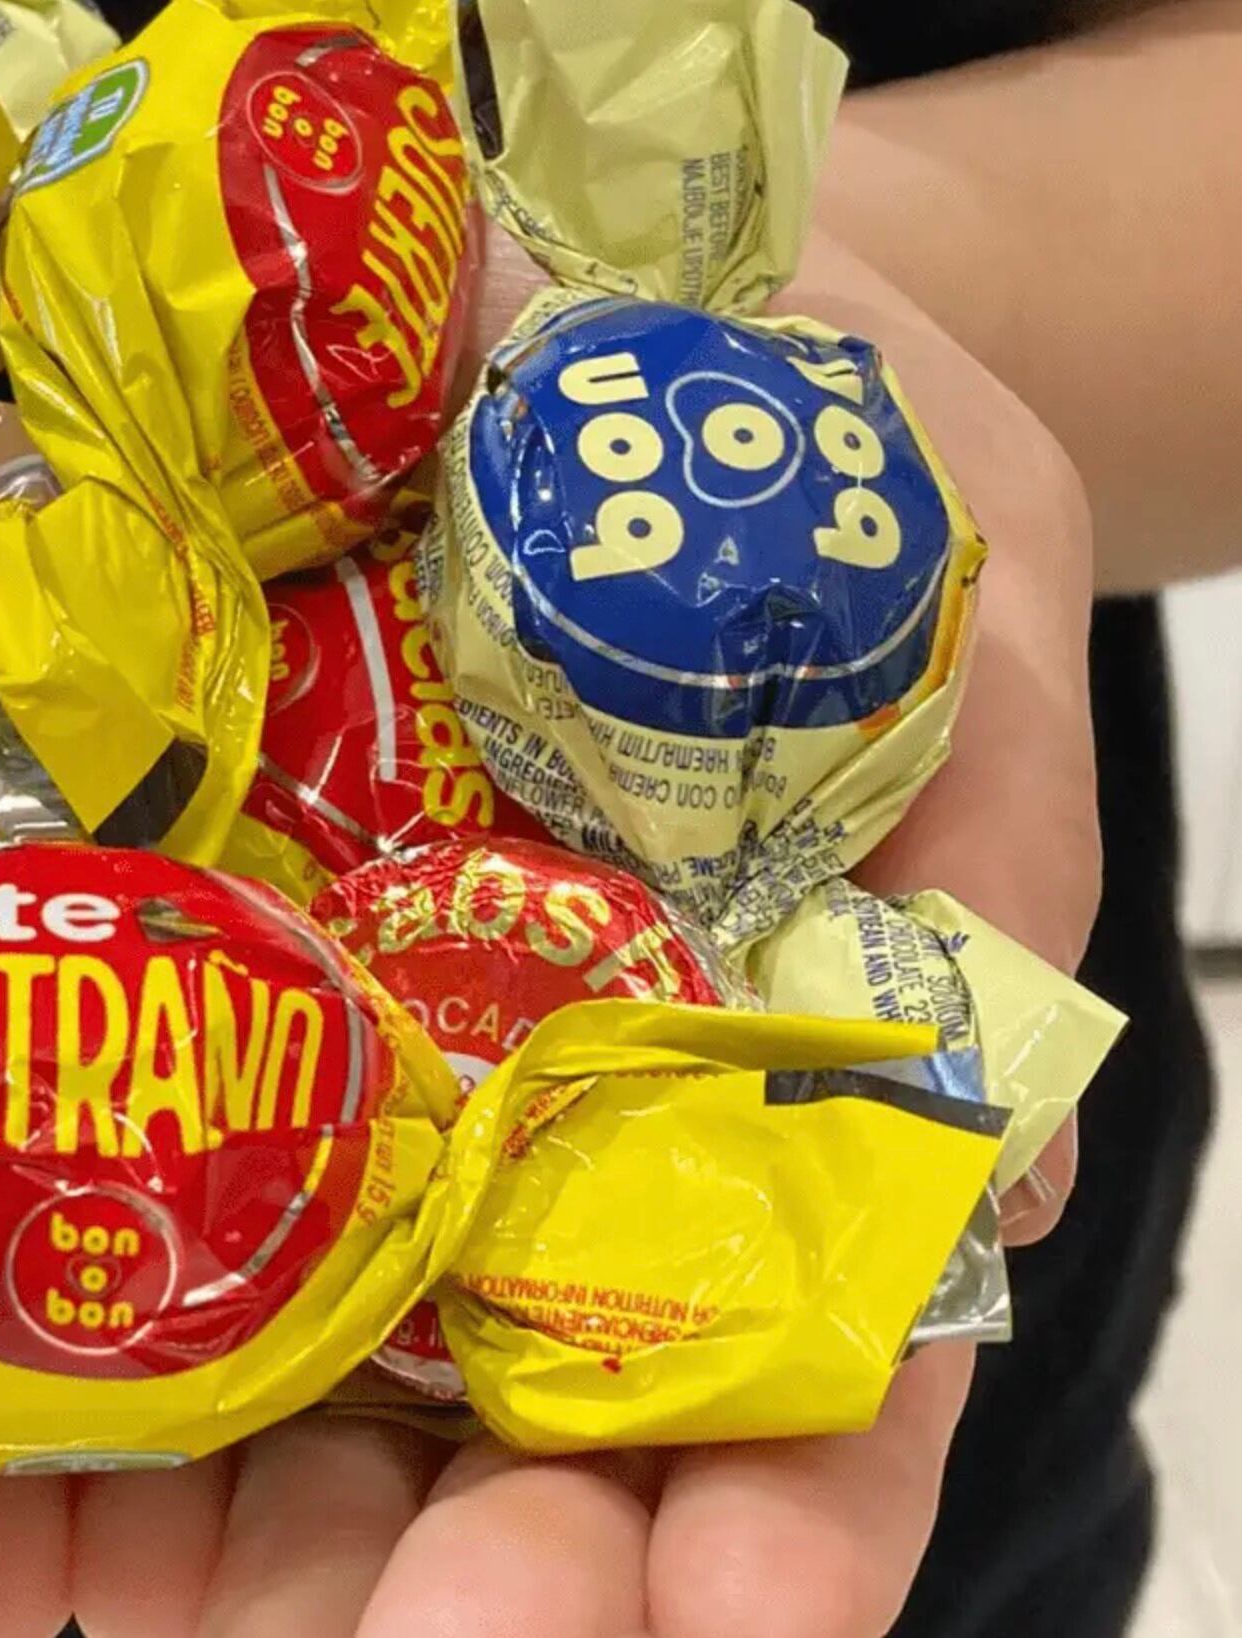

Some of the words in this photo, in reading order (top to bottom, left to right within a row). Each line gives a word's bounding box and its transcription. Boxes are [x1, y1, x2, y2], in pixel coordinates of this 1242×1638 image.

[260, 86, 303, 141] bon
[312, 117, 349, 171] bon
[702, 403, 785, 471] o
[558, 352, 685, 582] bon
[677, 785, 717, 811] CON
[864, 953, 893, 988] AND
[50, 1213, 142, 1257] bon
[80, 1265, 107, 1291] o
[45, 1288, 135, 1329] bon
